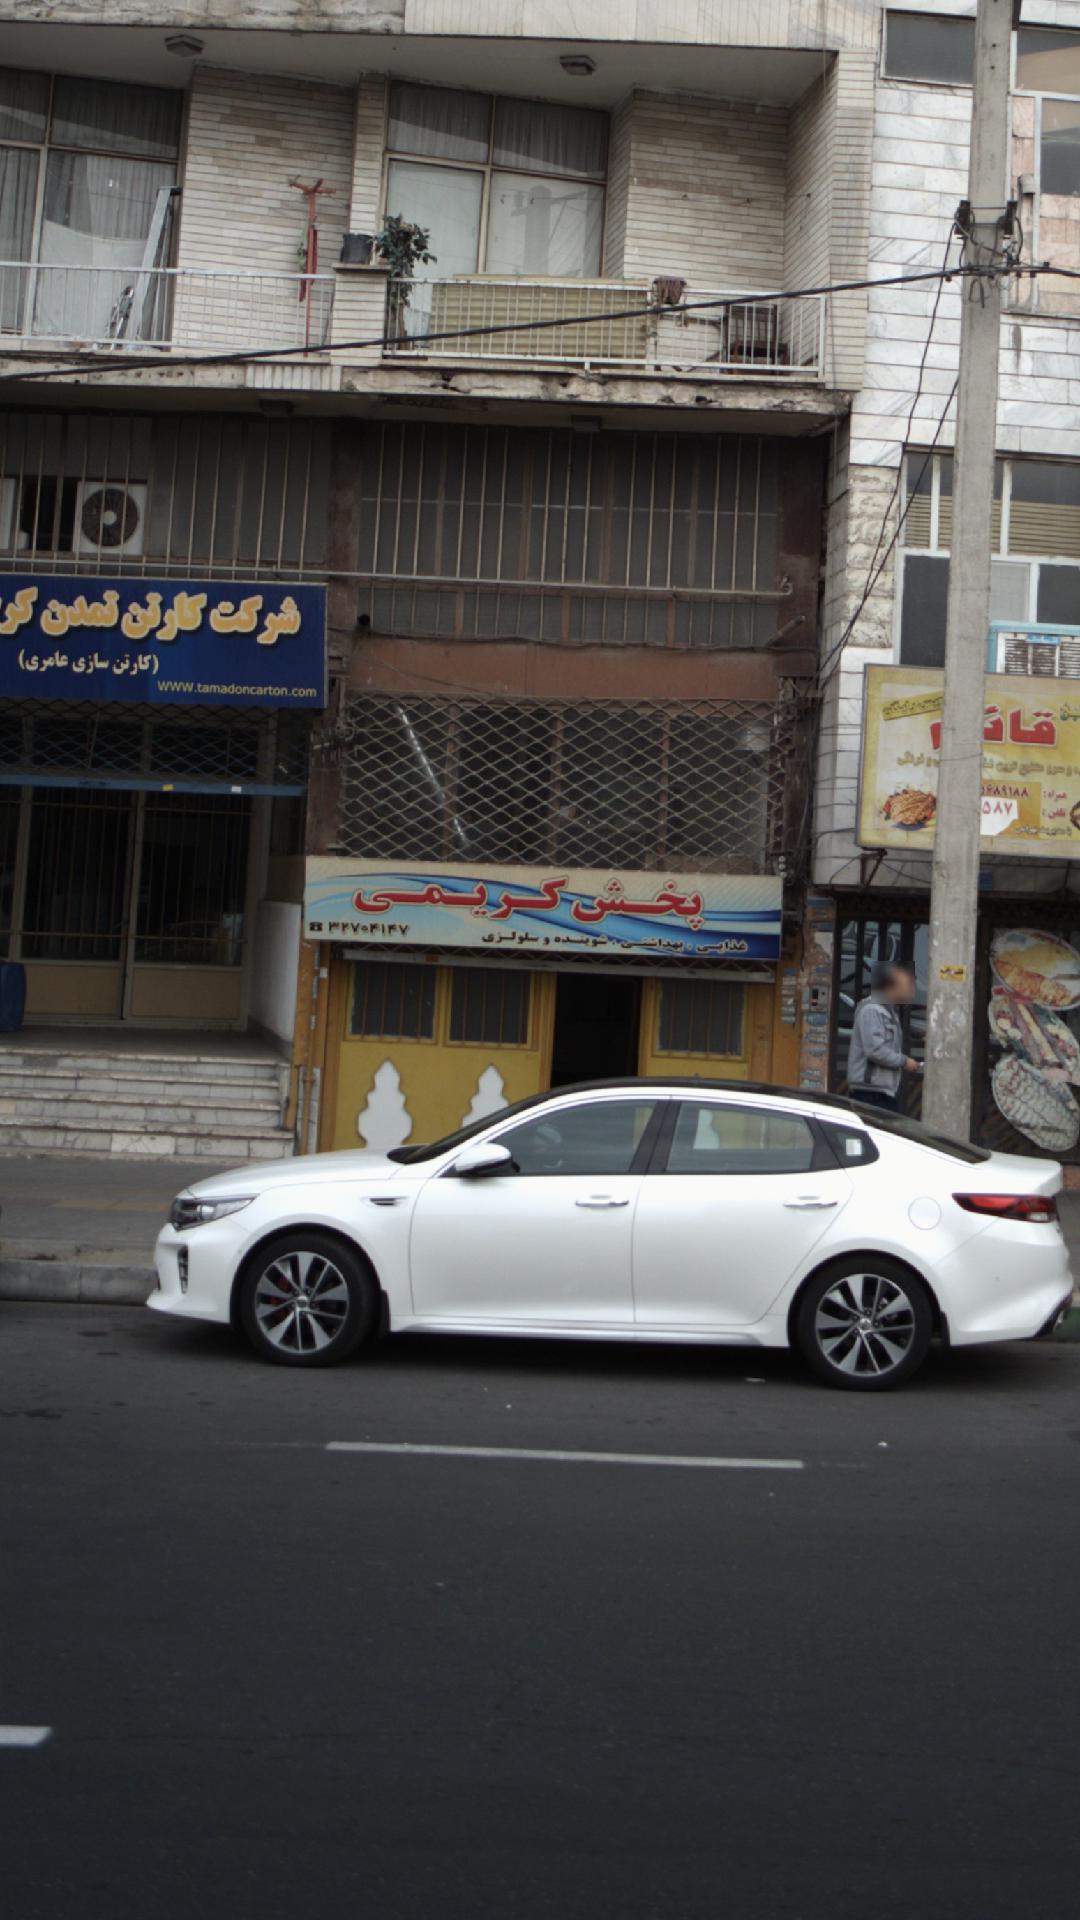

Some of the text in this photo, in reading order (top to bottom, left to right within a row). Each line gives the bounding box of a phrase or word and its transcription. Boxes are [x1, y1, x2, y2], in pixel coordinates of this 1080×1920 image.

[0, 585, 302, 645] شرکت کارتن تمدن کر
[72, 651, 110, 674] سازی
[353, 876, 705, 930] پخش کریمی
[481, 931, 539, 945] سلولزی
[555, 933, 608, 947] شوینده
[620, 937, 685, 953] بهداشتی
[697, 938, 748, 953] غذایی
